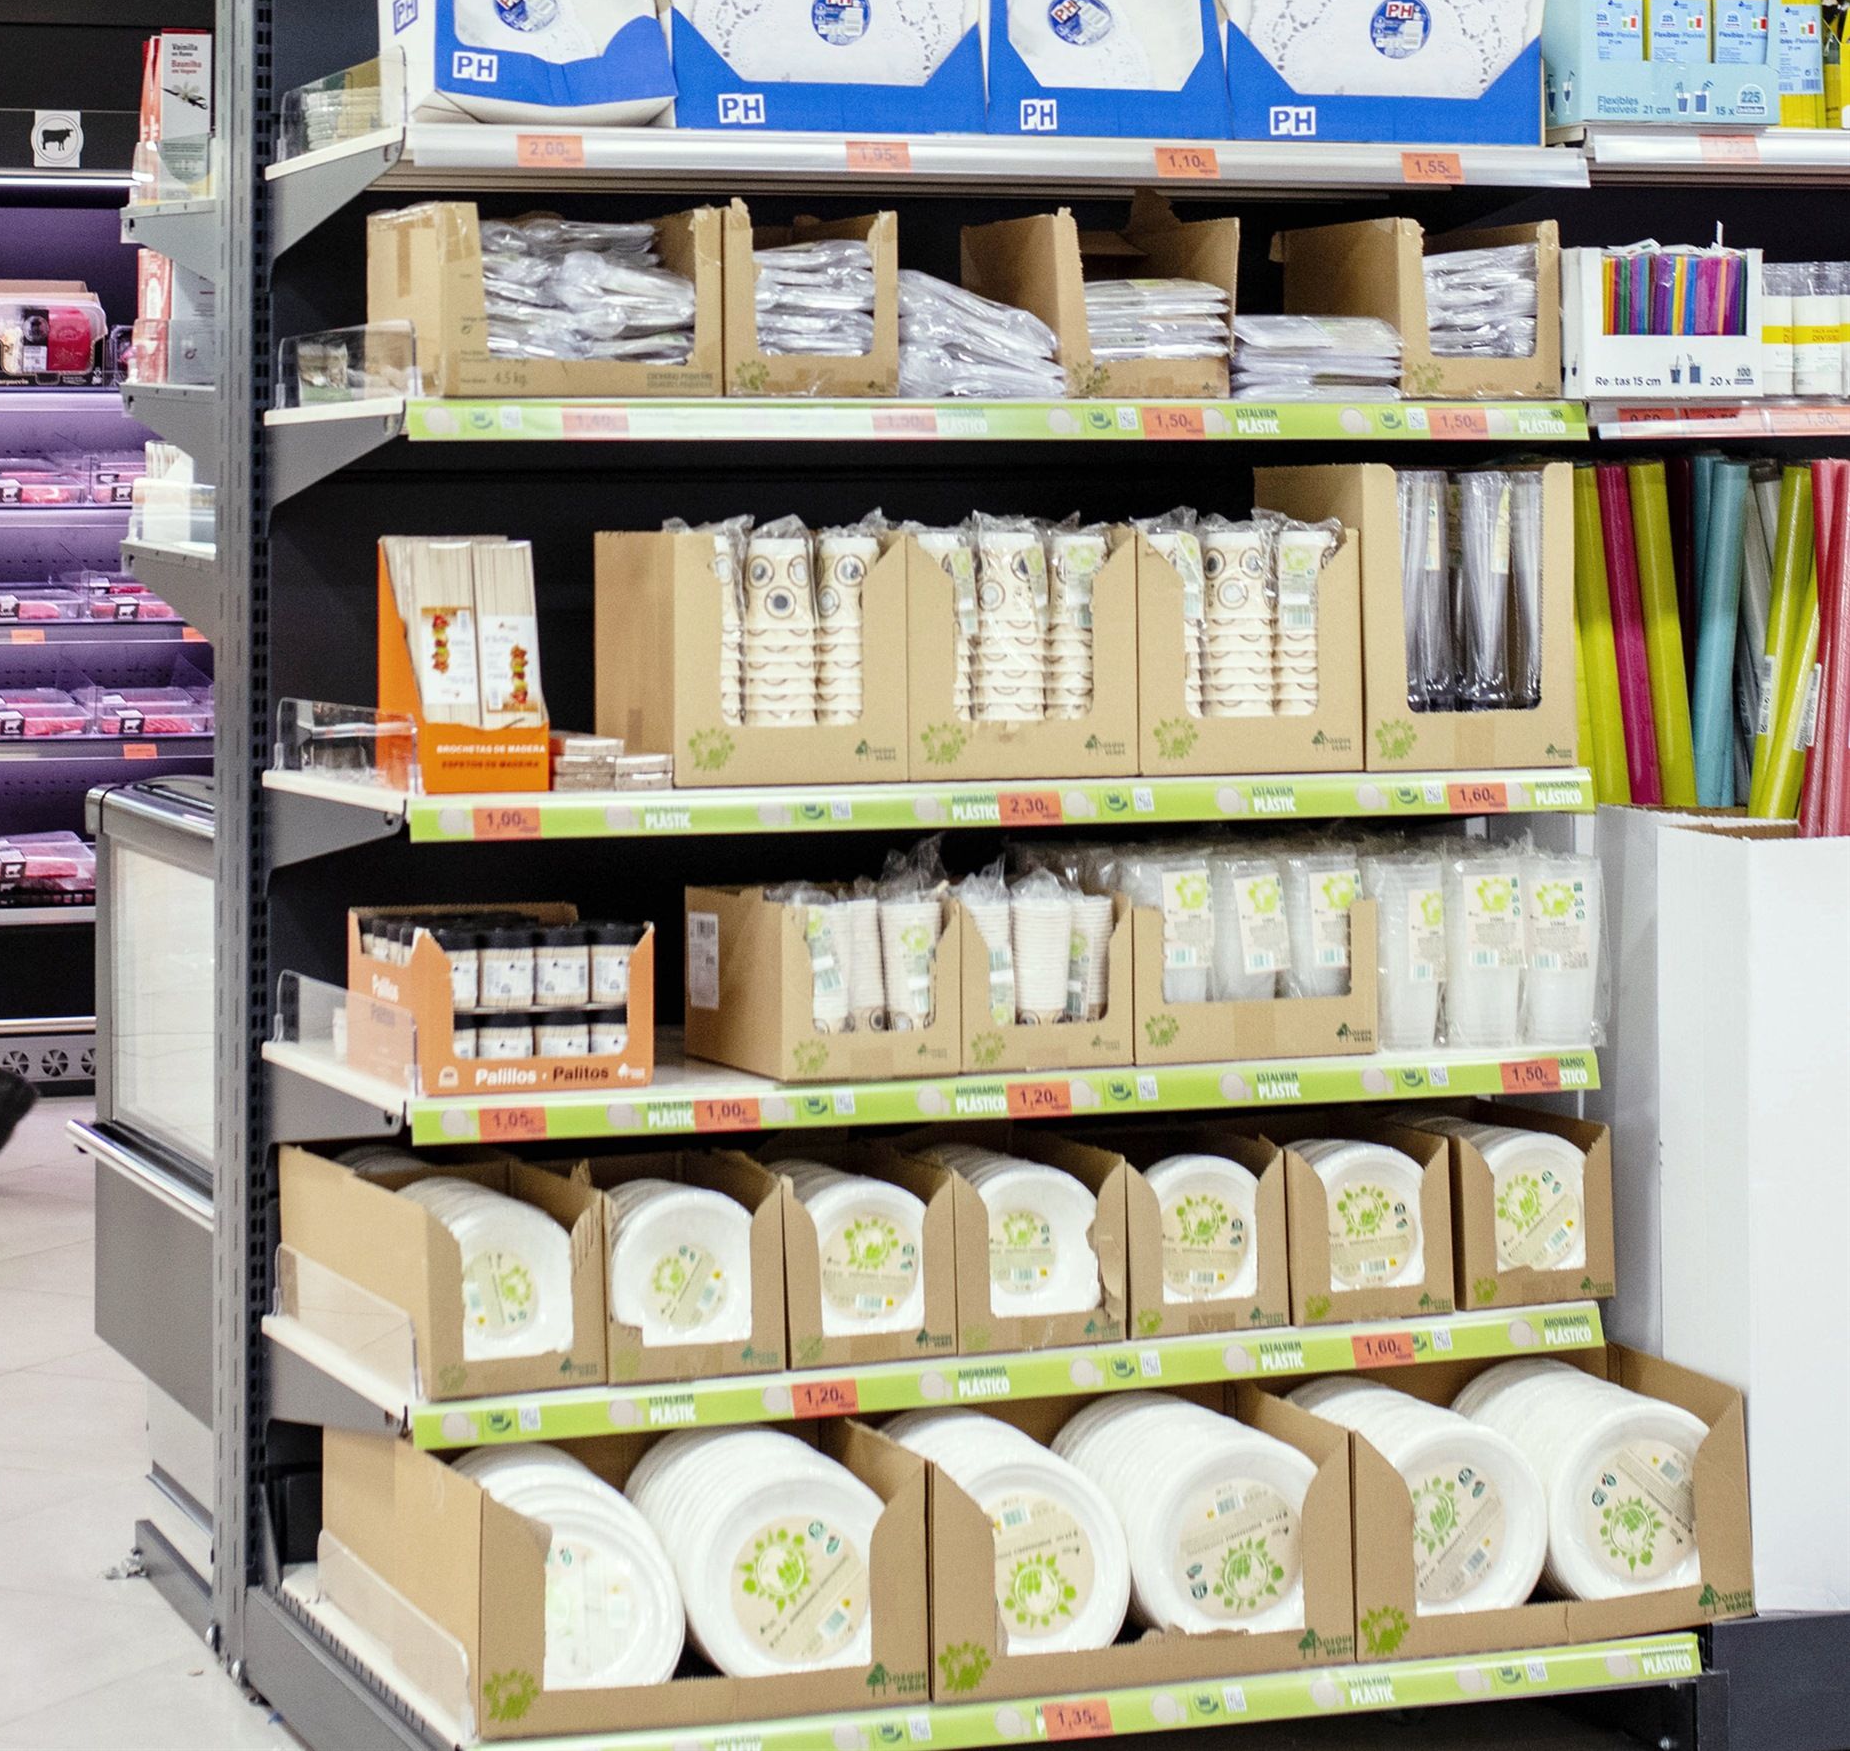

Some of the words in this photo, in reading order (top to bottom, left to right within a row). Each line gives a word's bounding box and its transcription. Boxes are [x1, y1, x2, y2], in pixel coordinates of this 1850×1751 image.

[1054, 0, 1078, 23] PH
[1389, 2, 1413, 19] PH
[457, 55, 495, 80] PH
[1740, 91, 1761, 104] 225
[722, 97, 762, 121] PH
[1023, 102, 1055, 128] PH
[1274, 109, 1313, 133] PH
[952, 794, 998, 805] AHORRAMO
[1535, 788, 1583, 806] PLÁSTICO
[475, 1067, 537, 1087] Palillos
[552, 1065, 609, 1083] Palitos
[1543, 1317, 1589, 1328] AHORRAMOS
[1544, 1327, 1592, 1344] PLÁSTICO
[958, 1367, 1007, 1379] AHORRAMOS
[958, 1379, 1010, 1397] PLÁSTICO
[1642, 1657, 1692, 1675] PLÁSTICO
